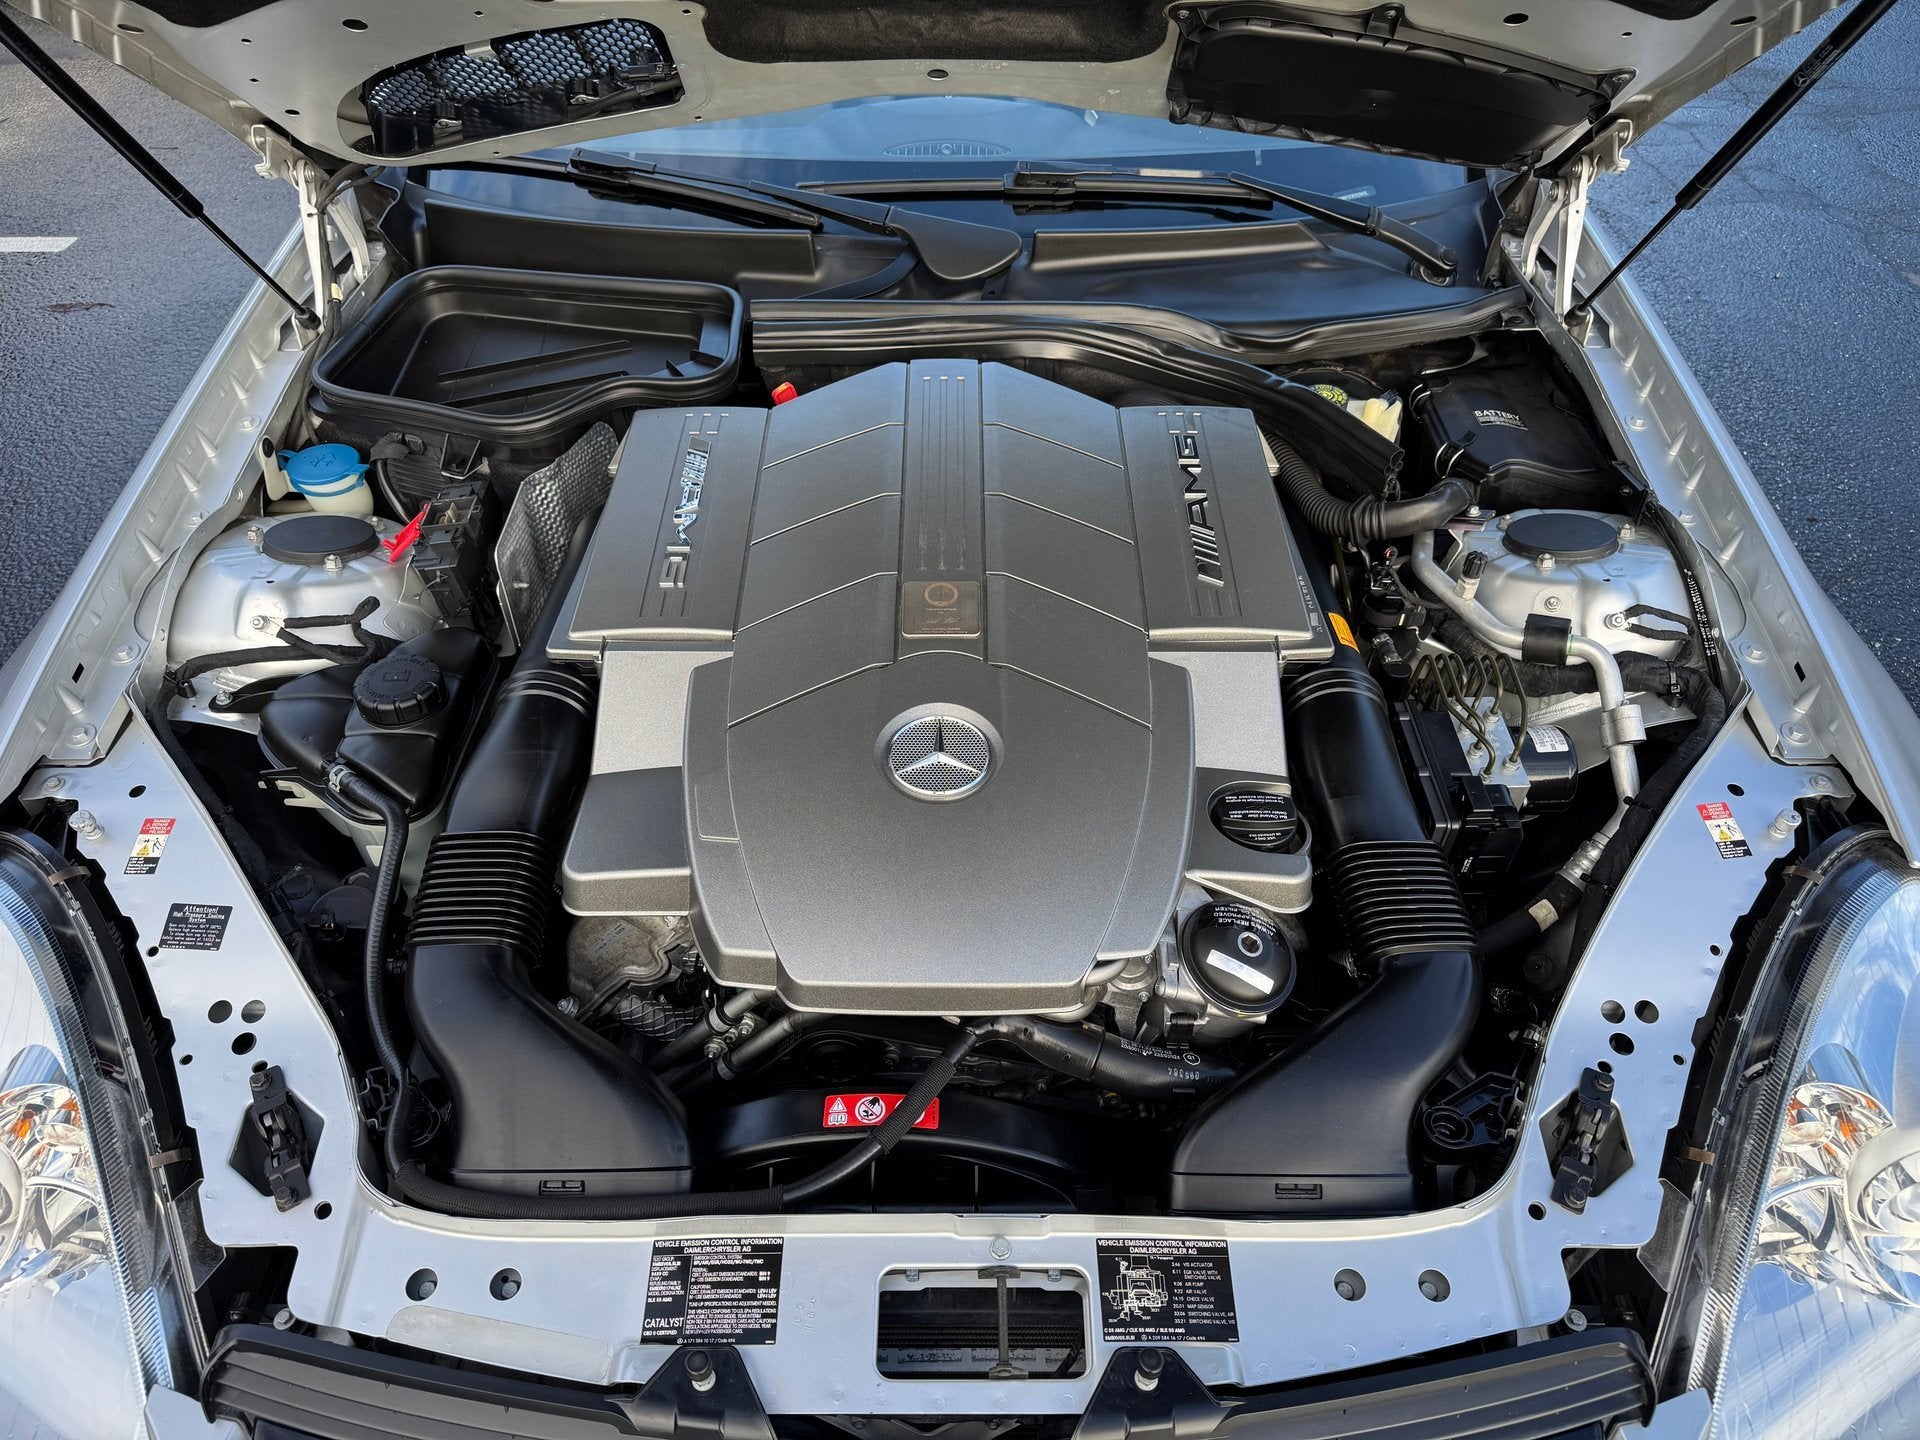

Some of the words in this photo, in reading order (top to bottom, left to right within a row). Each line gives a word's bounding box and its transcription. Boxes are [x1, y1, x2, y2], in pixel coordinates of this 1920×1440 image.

[1474, 410, 1520, 420] BATTERY
[1174, 435, 1215, 536] AMG
[1218, 918, 1249, 926] REPLACE
[644, 1318, 684, 1328] CATALYST
